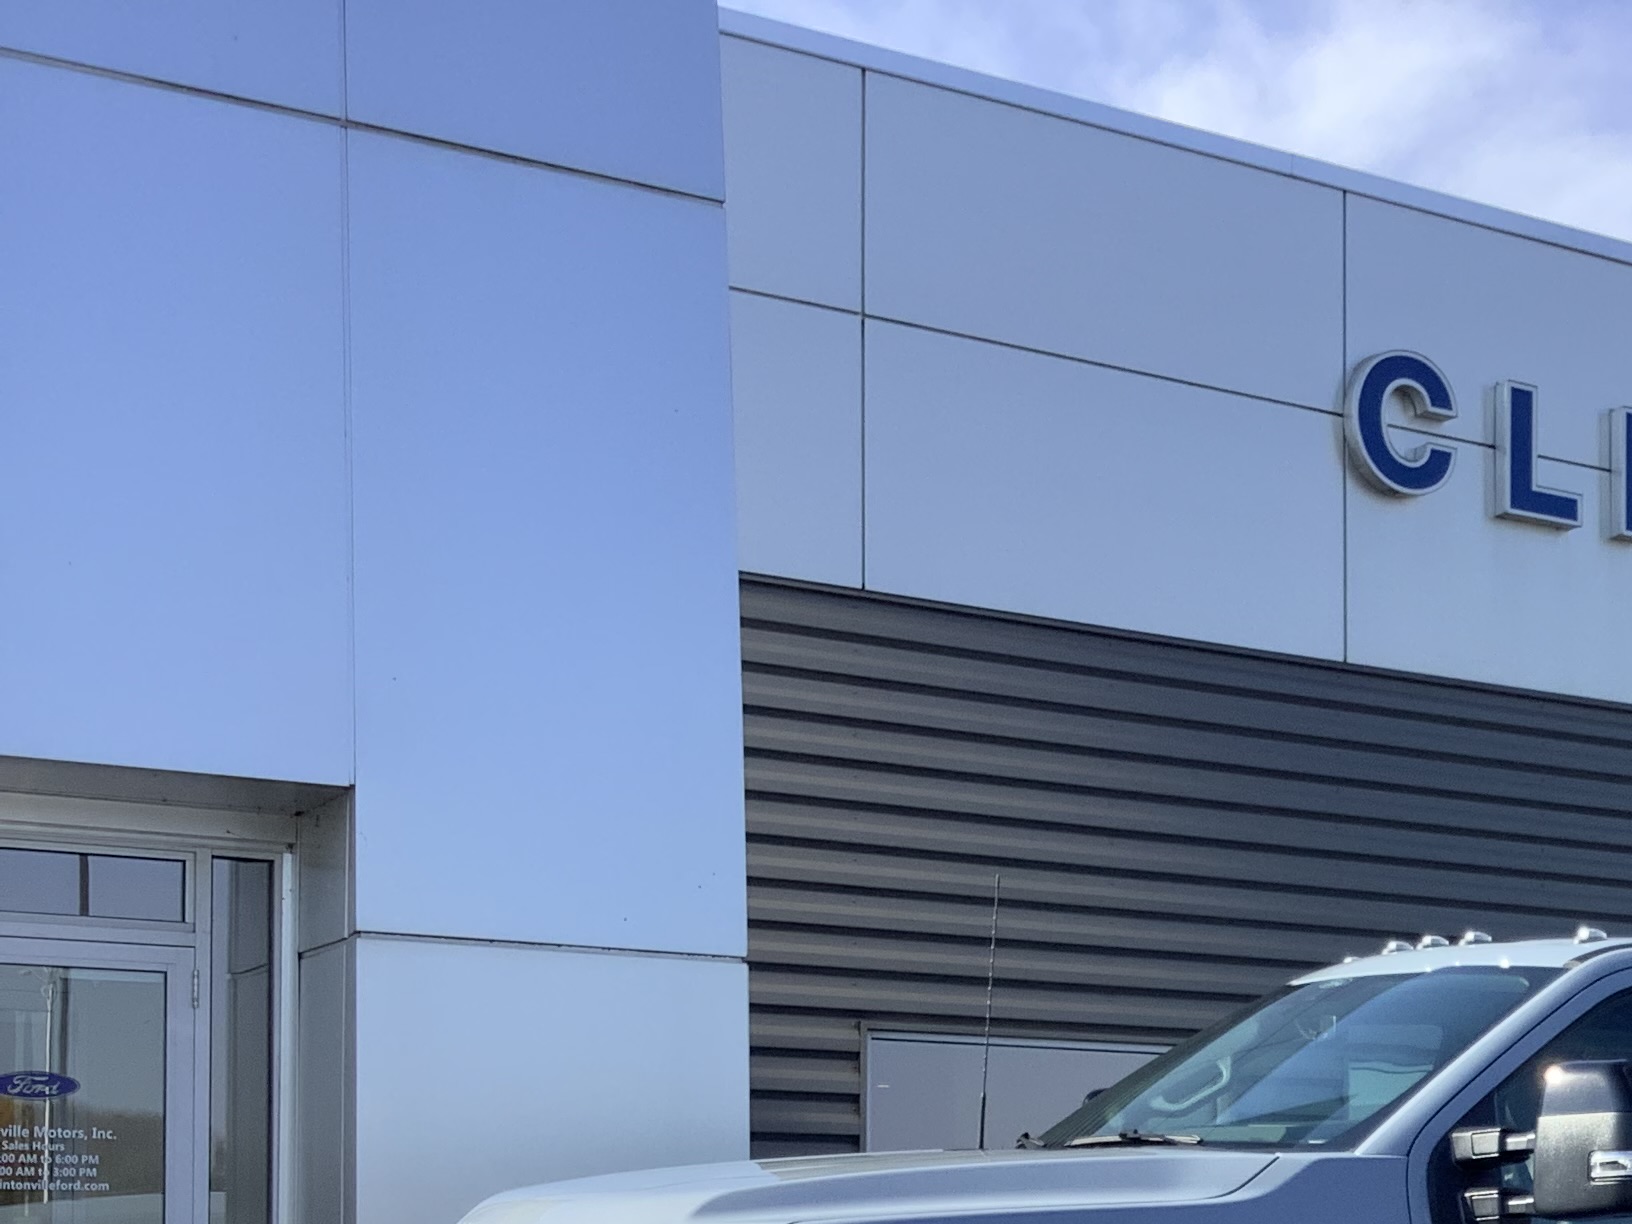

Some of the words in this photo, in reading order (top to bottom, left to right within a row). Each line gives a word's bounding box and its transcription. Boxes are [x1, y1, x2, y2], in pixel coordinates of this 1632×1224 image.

[7, 1075, 60, 1095] Ford
[34, 1126, 88, 1140] Motors,
[92, 1127, 117, 1140] Inc.
[2, 1141, 29, 1151] Sales
[33, 1142, 65, 1151] Hours
[18, 1154, 37, 1164] AM
[40, 1155, 52, 1164] to
[55, 1154, 78, 1165] 6:00
[81, 1155, 99, 1165] PM
[15, 1167, 34, 1176] AM
[53, 1168, 76, 1177] 3:00
[79, 1168, 97, 1177] PM
